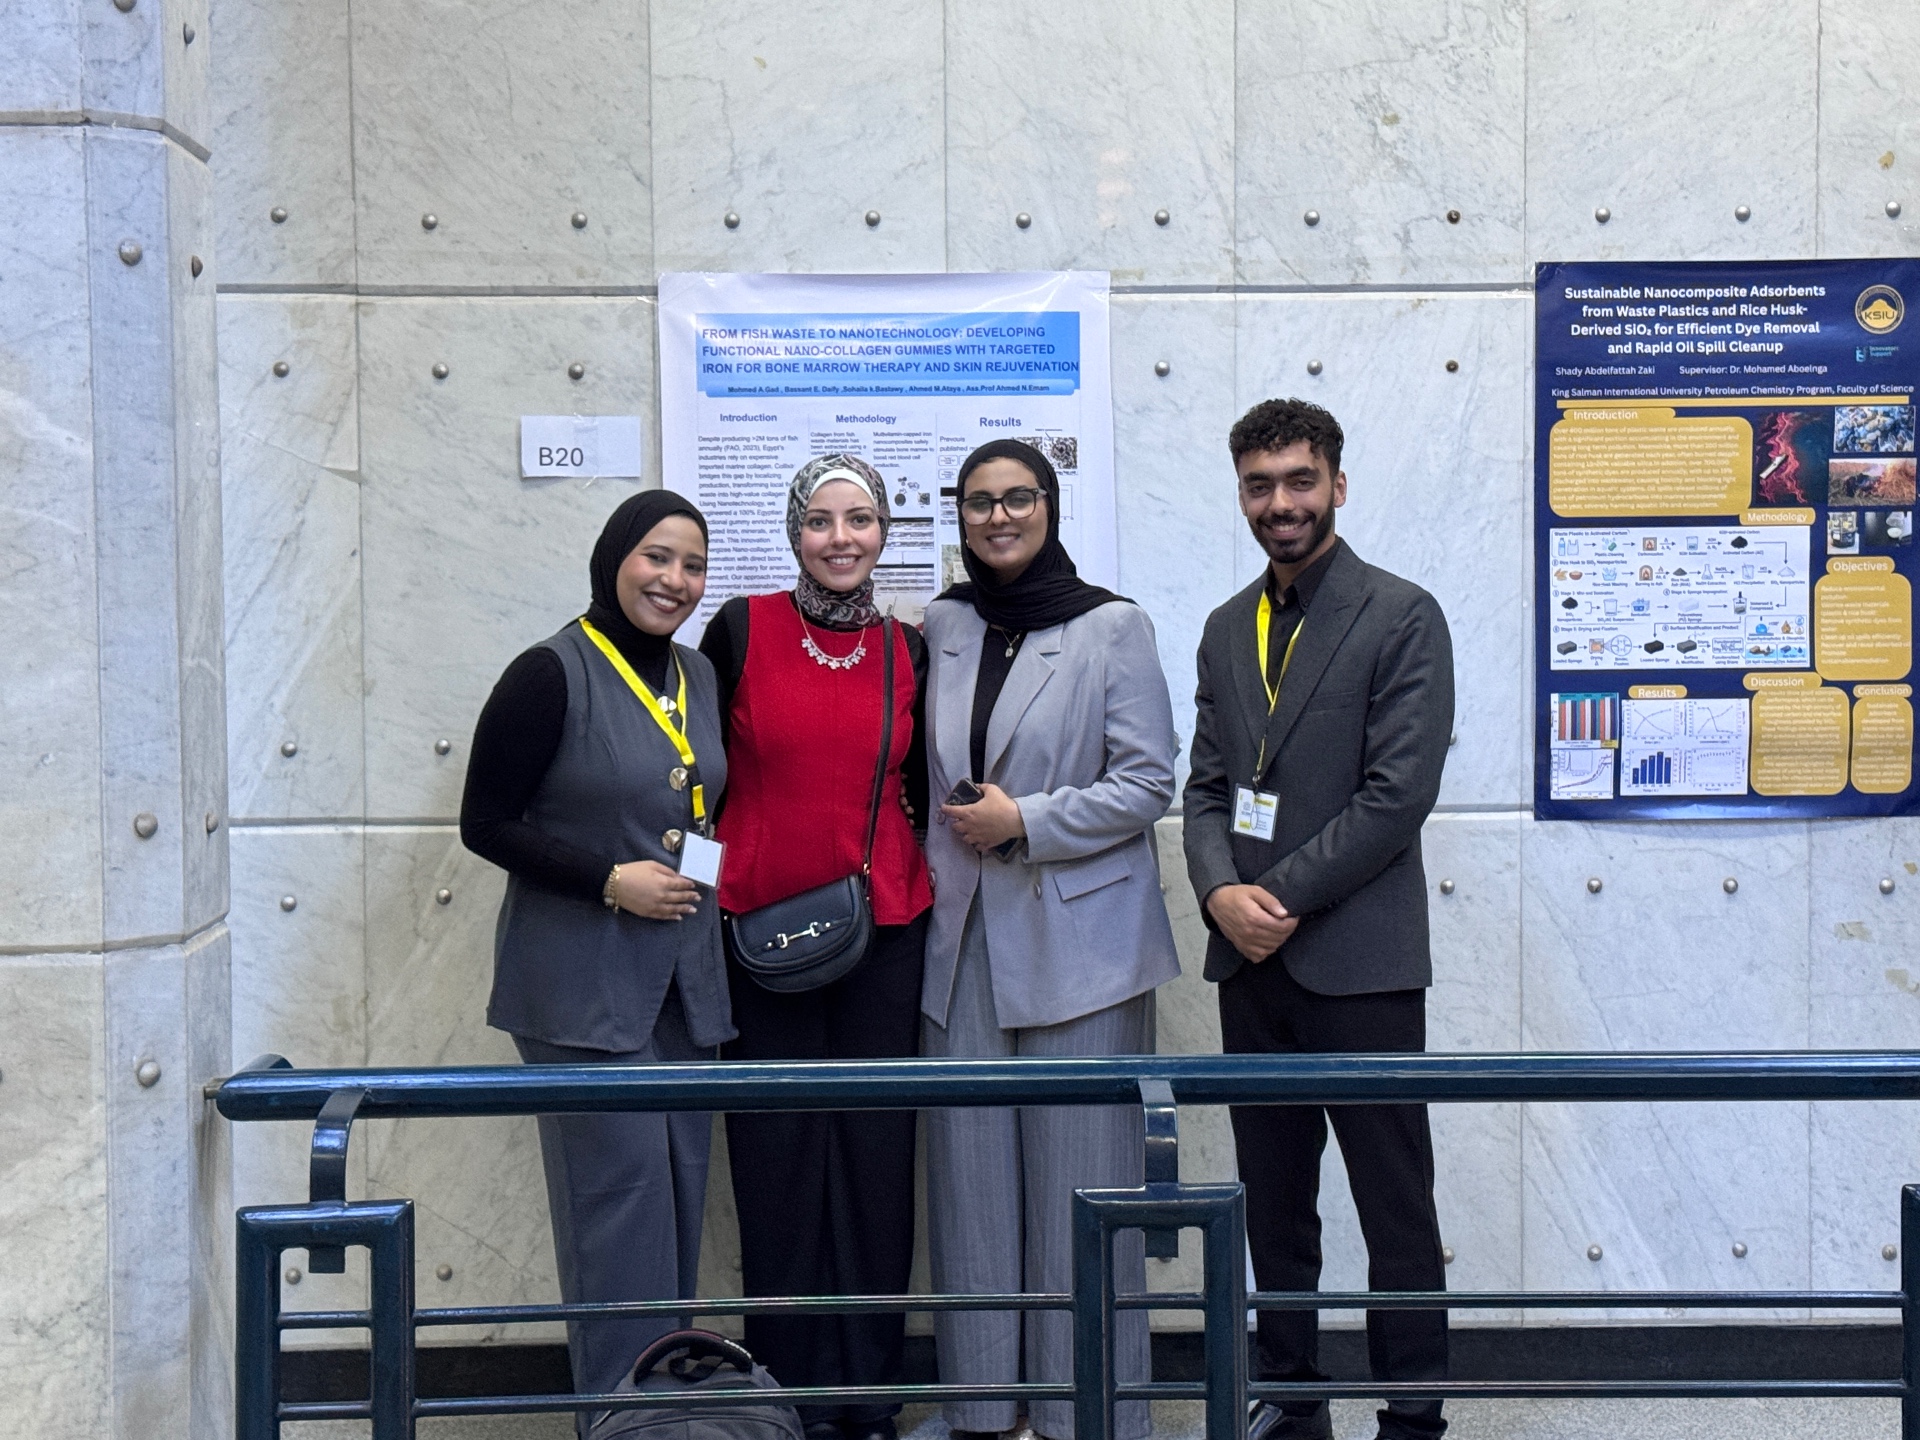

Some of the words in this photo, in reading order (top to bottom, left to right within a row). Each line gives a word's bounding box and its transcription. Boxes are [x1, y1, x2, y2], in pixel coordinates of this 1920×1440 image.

[1564, 287, 1641, 299] Sustainable
[1643, 286, 1747, 301] Nanocomposite
[1749, 286, 1826, 297] Adsorbents
[1582, 305, 1613, 317] from
[1616, 305, 1656, 317] Waste
[1658, 305, 1709, 316] Plastics
[1711, 305, 1736, 316] and
[1739, 304, 1767, 316] Rice
[1770, 304, 1808, 315] Husk-
[1864, 311, 1895, 320] KSIU
[702, 328, 738, 339] FROM
[740, 328, 770, 339] FISH
[769, 328, 818, 339] WASTE
[817, 328, 837, 338] TO
[836, 327, 962, 338] NANOTECHNOLOGY:
[965, 327, 1046, 338] DEVELOPING
[1570, 324, 1621, 336] Derived
[1654, 324, 1674, 335] for
[1676, 323, 1732, 335] Efficient
[1734, 323, 1761, 337] Dye
[1763, 322, 1820, 334] Removal
[702, 345, 781, 356] FUNCTIONAL
[783, 345, 892, 356] NANO-COLLAGEN
[894, 345, 952, 355] GUMMIES
[955, 345, 986, 355] WITH
[990, 344, 1055, 355] TARGETED
[1607, 342, 1632, 354] and
[1635, 342, 1672, 356] Rapid
[1675, 342, 1694, 353] Oil
[1696, 342, 1726, 355] Spill
[1728, 341, 1783, 355] Cleanup
[702, 363, 733, 373] IRON
[735, 362, 762, 373] FOR
[764, 362, 800, 373] BONE
[803, 362, 863, 373] MARROW
[864, 362, 920, 373] THERAPY
[924, 362, 950, 372] AND
[953, 362, 982, 372] SKIN
[985, 361, 1080, 372] REJUVENATION
[1555, 367, 1582, 377] Shady
[1584, 366, 1636, 375] Abdelfattah
[1637, 366, 1655, 374] Zaki
[1679, 366, 1728, 376] Supervisor:
[1743, 365, 1786, 373] Mohamed
[1551, 388, 1570, 398] King
[1571, 388, 1602, 396] Salman
[1603, 388, 1658, 396] International
[1659, 387, 1702, 397] University
[1704, 387, 1749, 395] Petroleum
[1750, 386, 1794, 396] Chemistry
[1796, 386, 1835, 396] Program,
[1836, 386, 1868, 395] Faculty
[1869, 385, 1878, 393] of
[1880, 385, 1914, 393] Science
[720, 414, 778, 422] Introduction
[836, 415, 897, 425] Methodology
[1573, 410, 1638, 419] Introduction
[980, 417, 1022, 427] Results
[539, 447, 584, 467] B20
[1748, 512, 1807, 524] Methodology
[1833, 562, 1888, 573] Objectives
[1750, 677, 1804, 686] Discussion
[1638, 688, 1676, 698] Results
